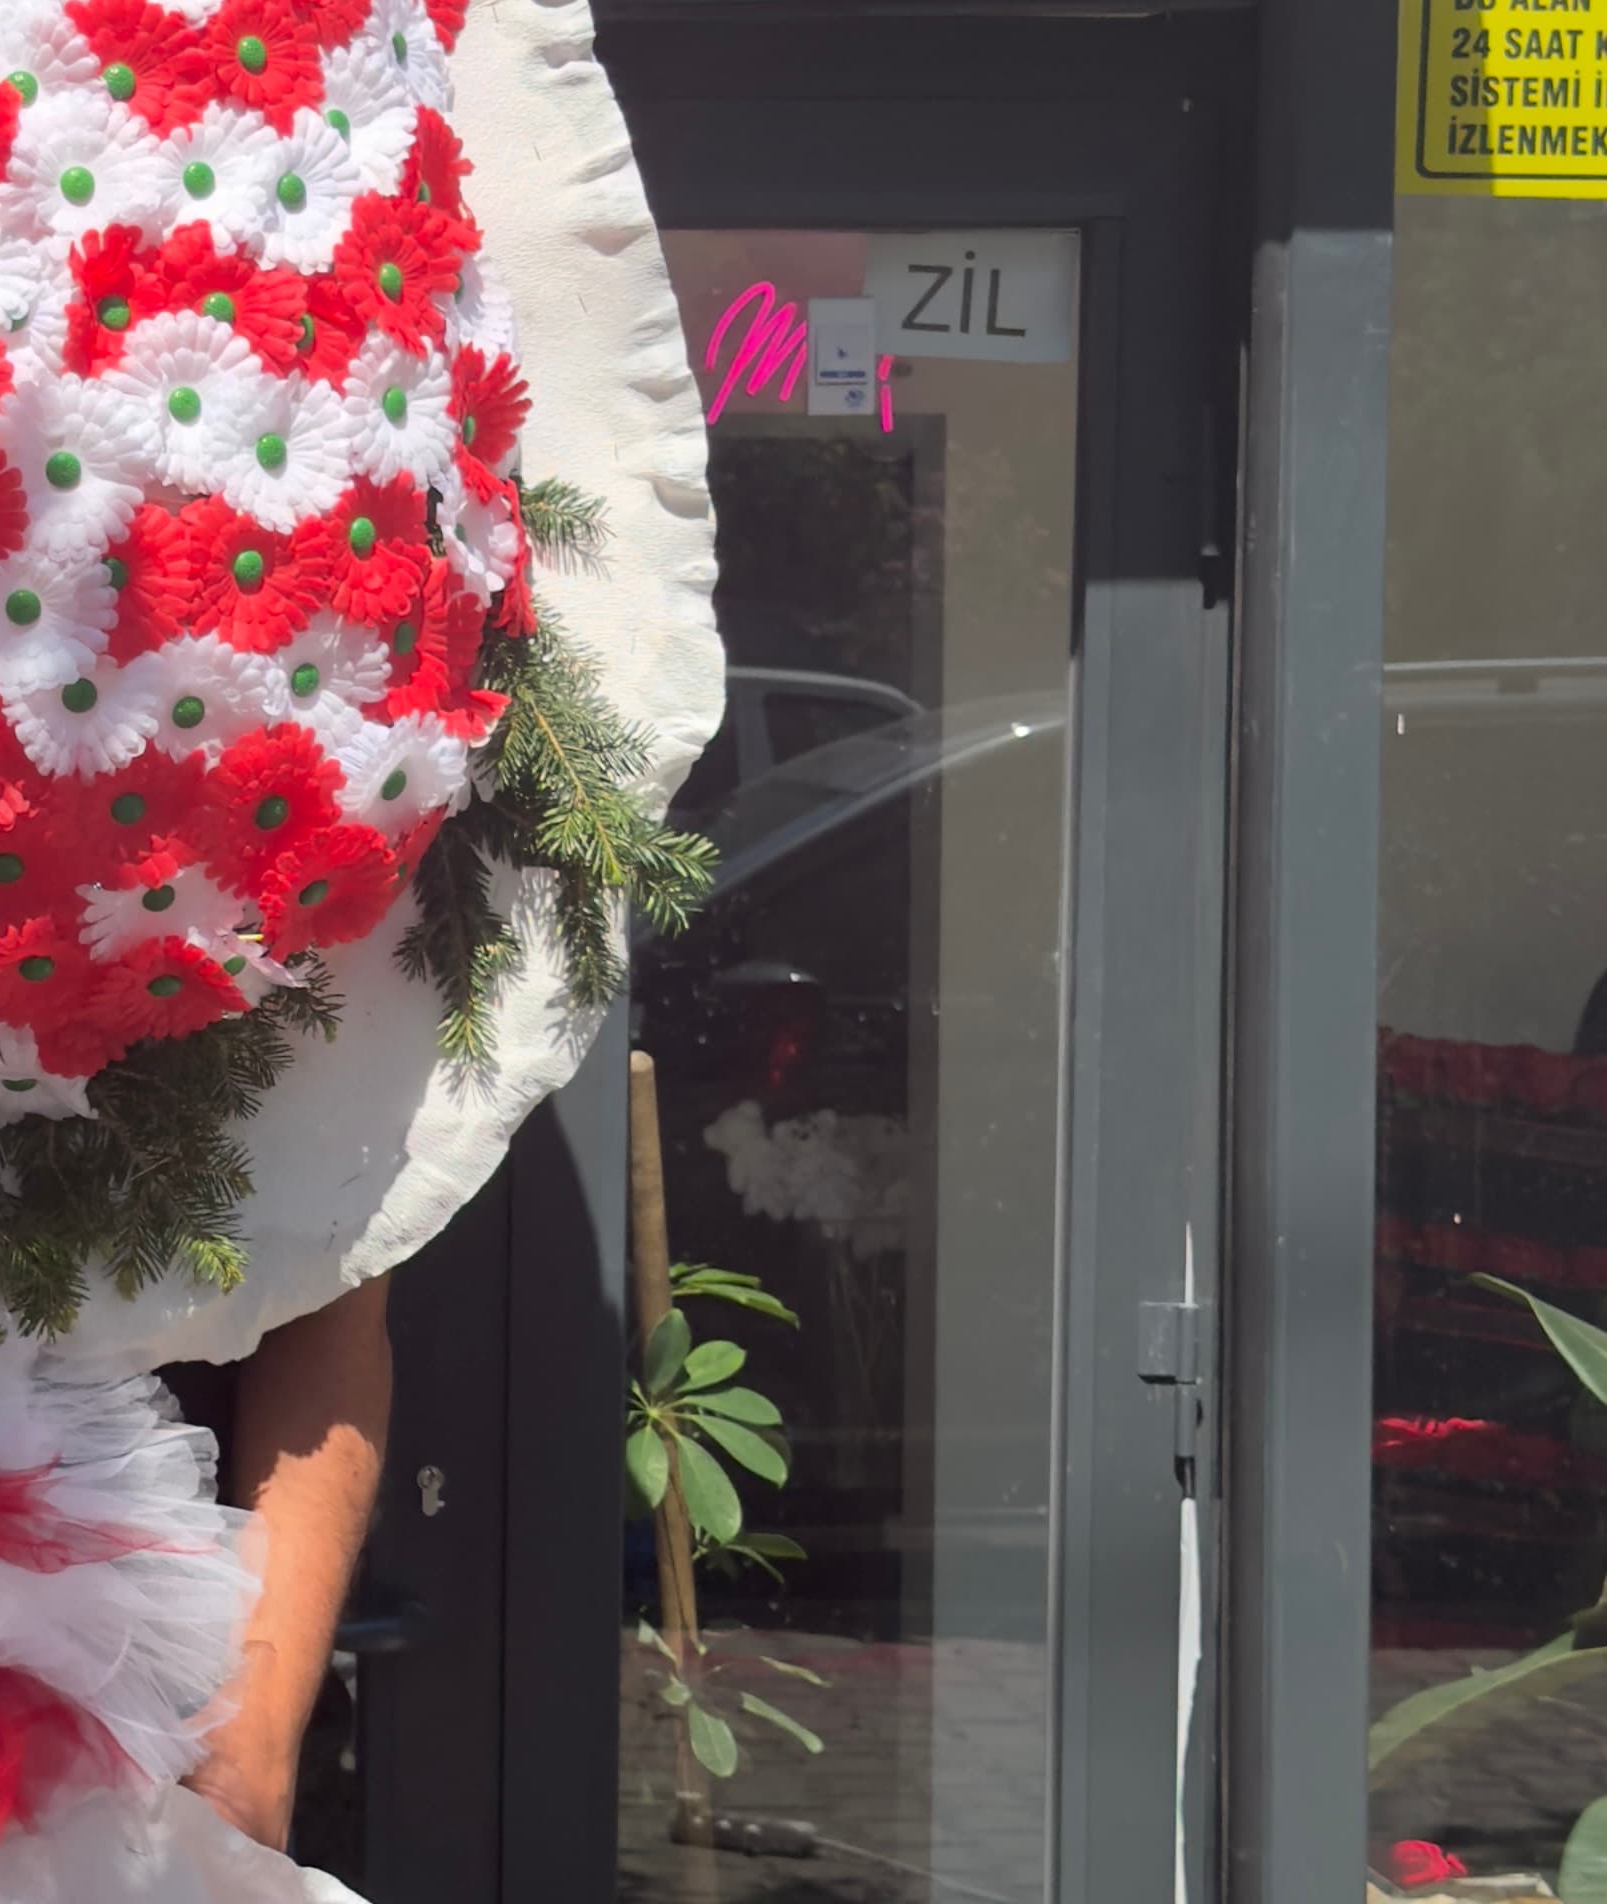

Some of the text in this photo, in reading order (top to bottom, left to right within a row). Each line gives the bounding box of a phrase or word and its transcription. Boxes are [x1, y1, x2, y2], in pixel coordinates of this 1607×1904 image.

[1451, 27, 1491, 59] 24
[1504, 28, 1584, 60] SAAT
[1450, 68, 1581, 108] SİSTEMİ
[1447, 115, 1607, 157] İZLENMEK
[901, 250, 1026, 338] ZİL
